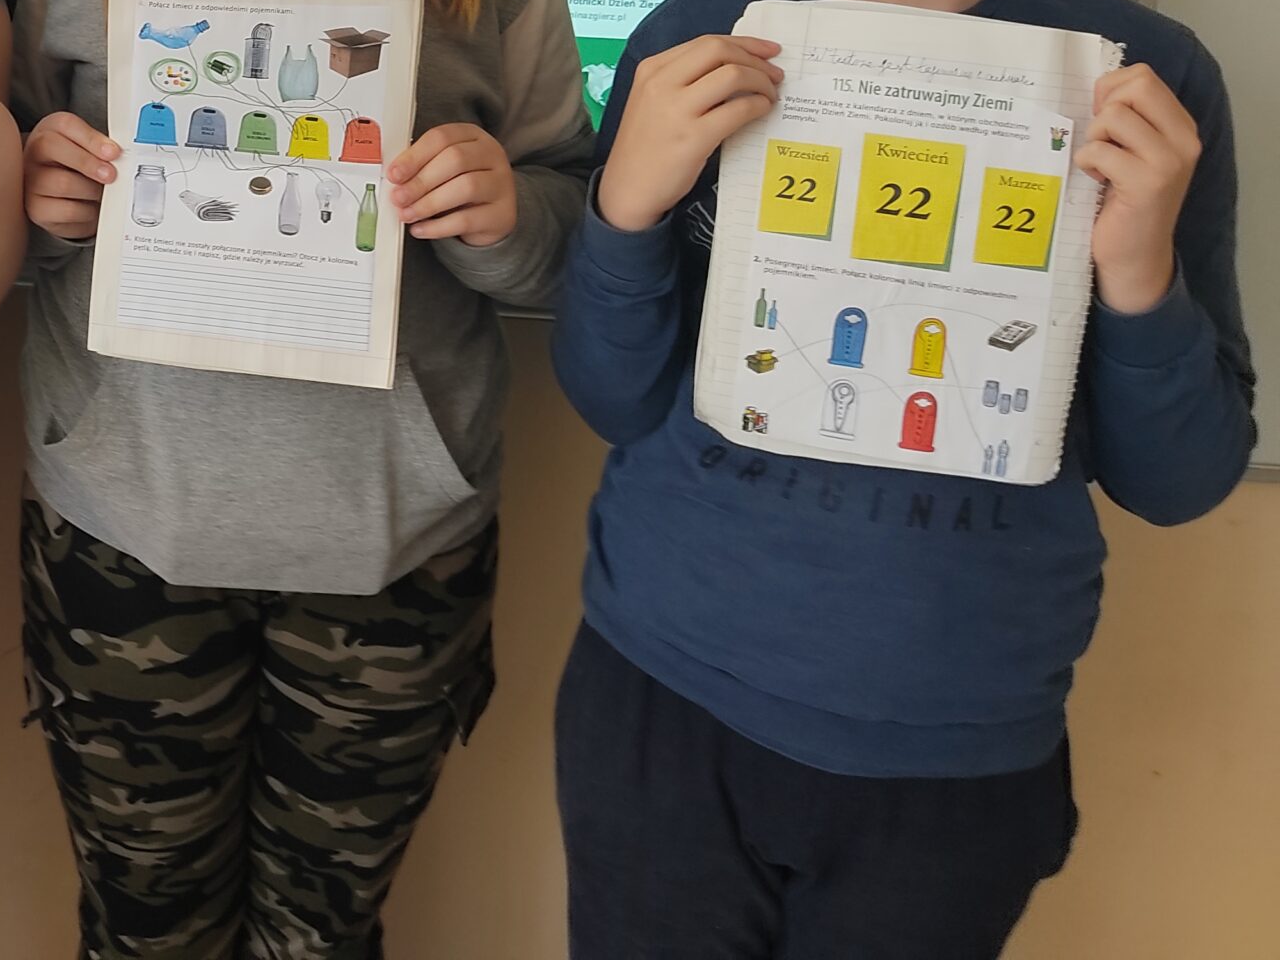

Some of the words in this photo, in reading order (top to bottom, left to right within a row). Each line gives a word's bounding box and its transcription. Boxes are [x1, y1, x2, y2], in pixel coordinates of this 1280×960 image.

[832, 77, 854, 92] 115.
[858, 79, 882, 96] Nie
[883, 84, 970, 110] zatruwajmy
[971, 92, 1013, 112] Ziemi
[776, 145, 829, 162] Wrzesień
[876, 142, 949, 165] Kwiecień
[775, 174, 816, 203] 22
[998, 174, 1045, 191] Marzec
[874, 181, 931, 220] 22
[991, 203, 1035, 234] 22
